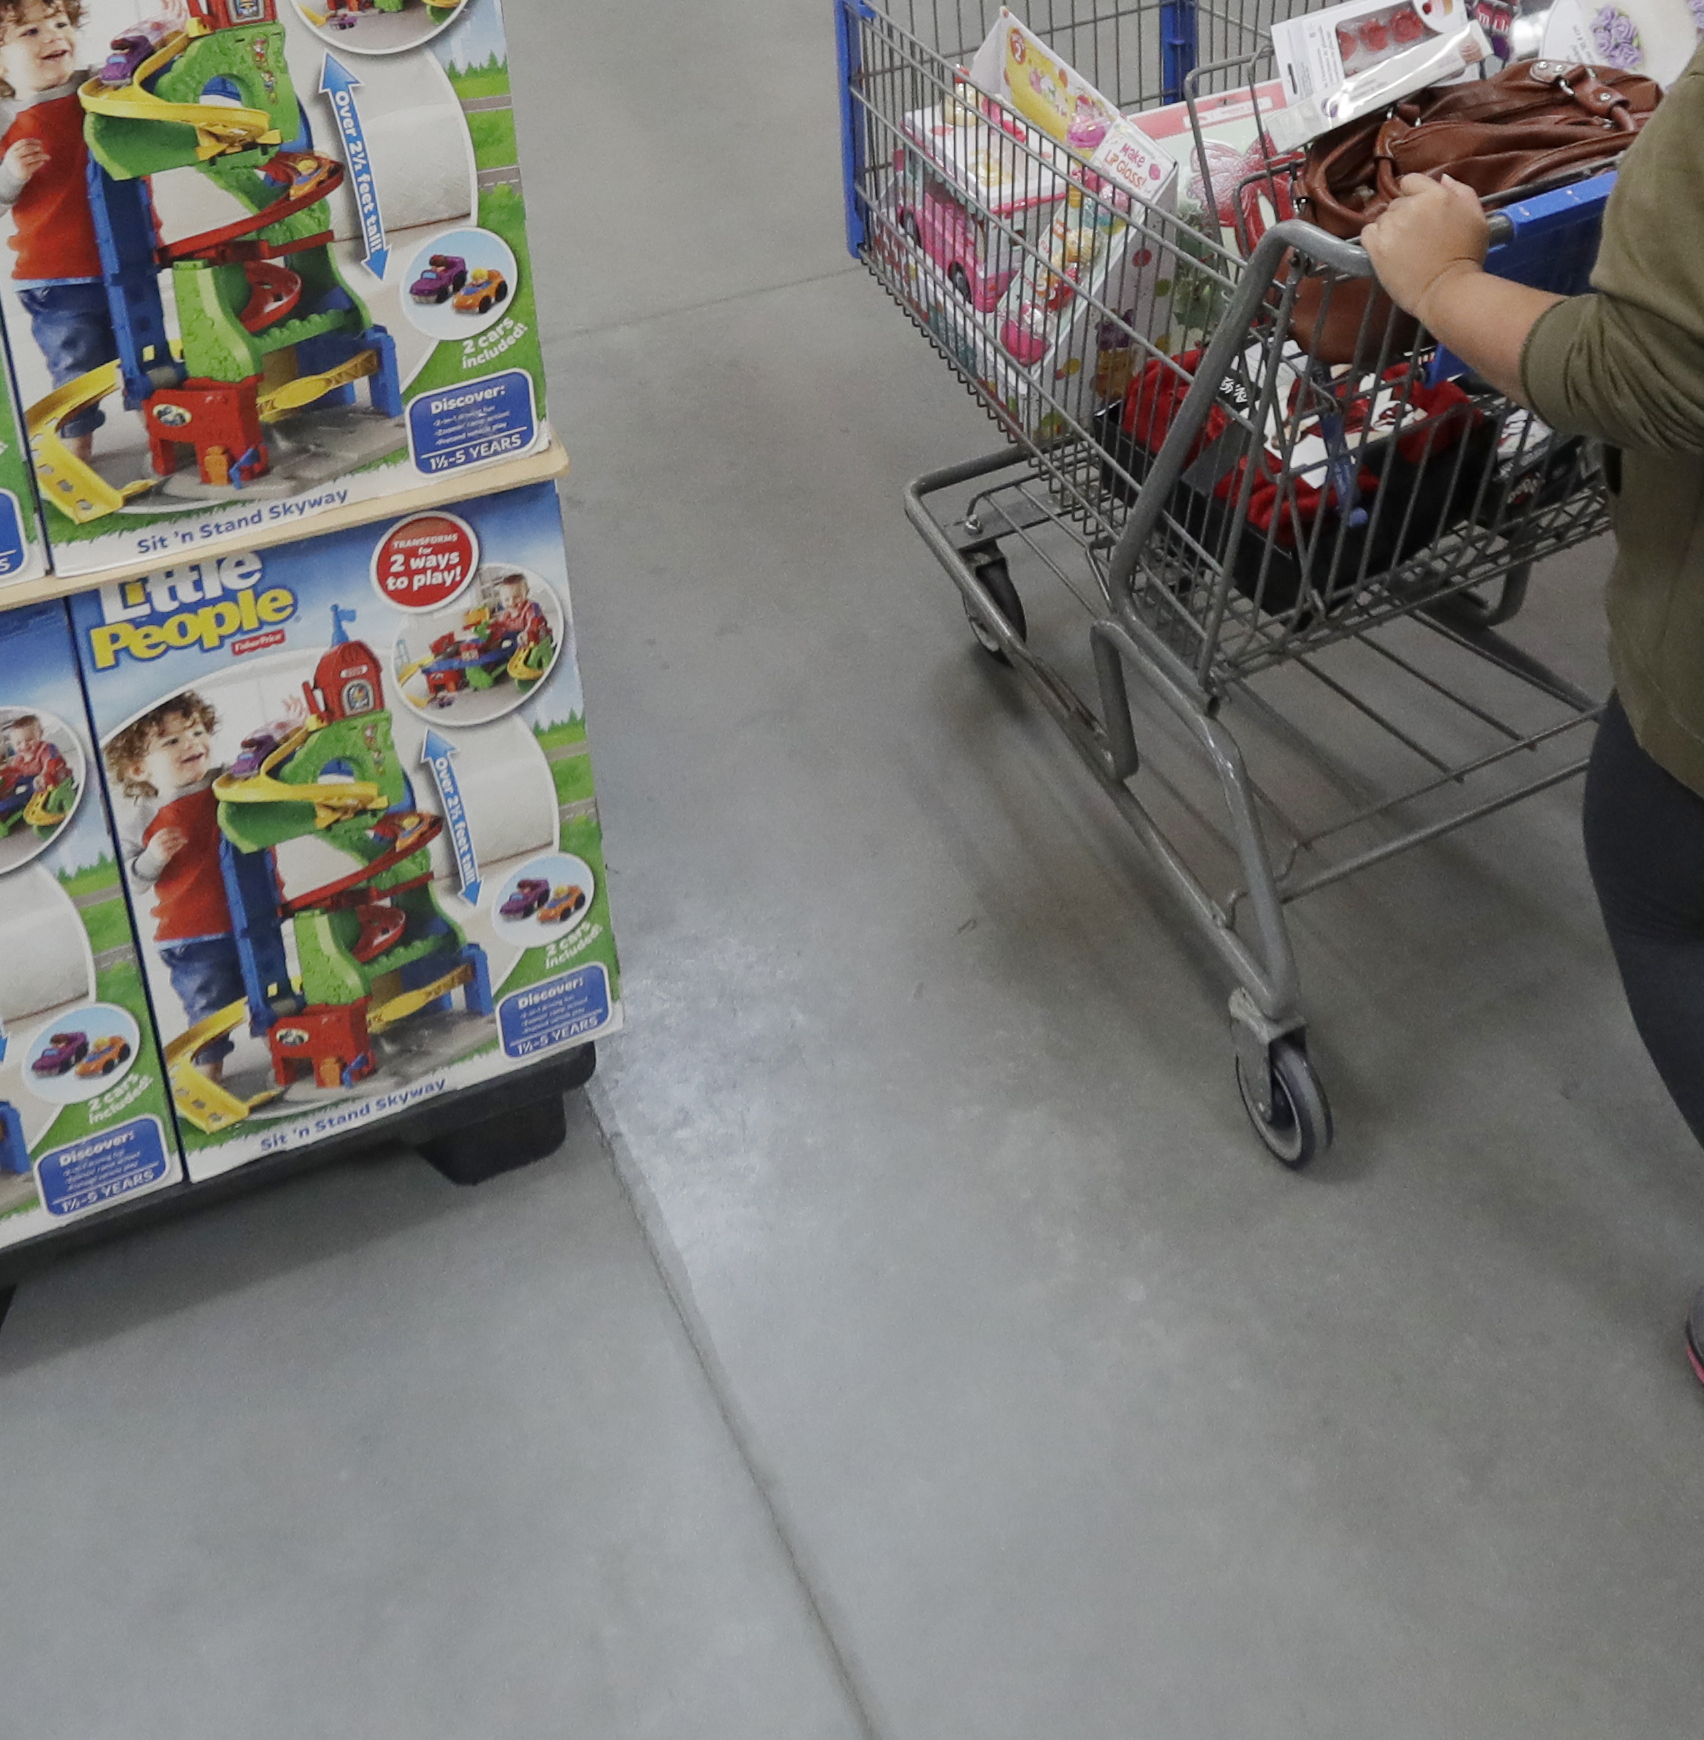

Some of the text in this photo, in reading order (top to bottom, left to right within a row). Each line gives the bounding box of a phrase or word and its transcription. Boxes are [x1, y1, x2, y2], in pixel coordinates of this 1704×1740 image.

[334, 90, 357, 136] Over
[356, 171, 377, 214] feet
[365, 213, 383, 253] tall!
[461, 316, 515, 356] 2 cars
[461, 321, 529, 369] included!
[429, 383, 508, 416] Discover:
[468, 433, 524, 460] YEARS
[135, 534, 168, 555] Sit
[198, 508, 263, 540] Stand
[267, 487, 348, 521] Skyway
[89, 586, 294, 672] People
